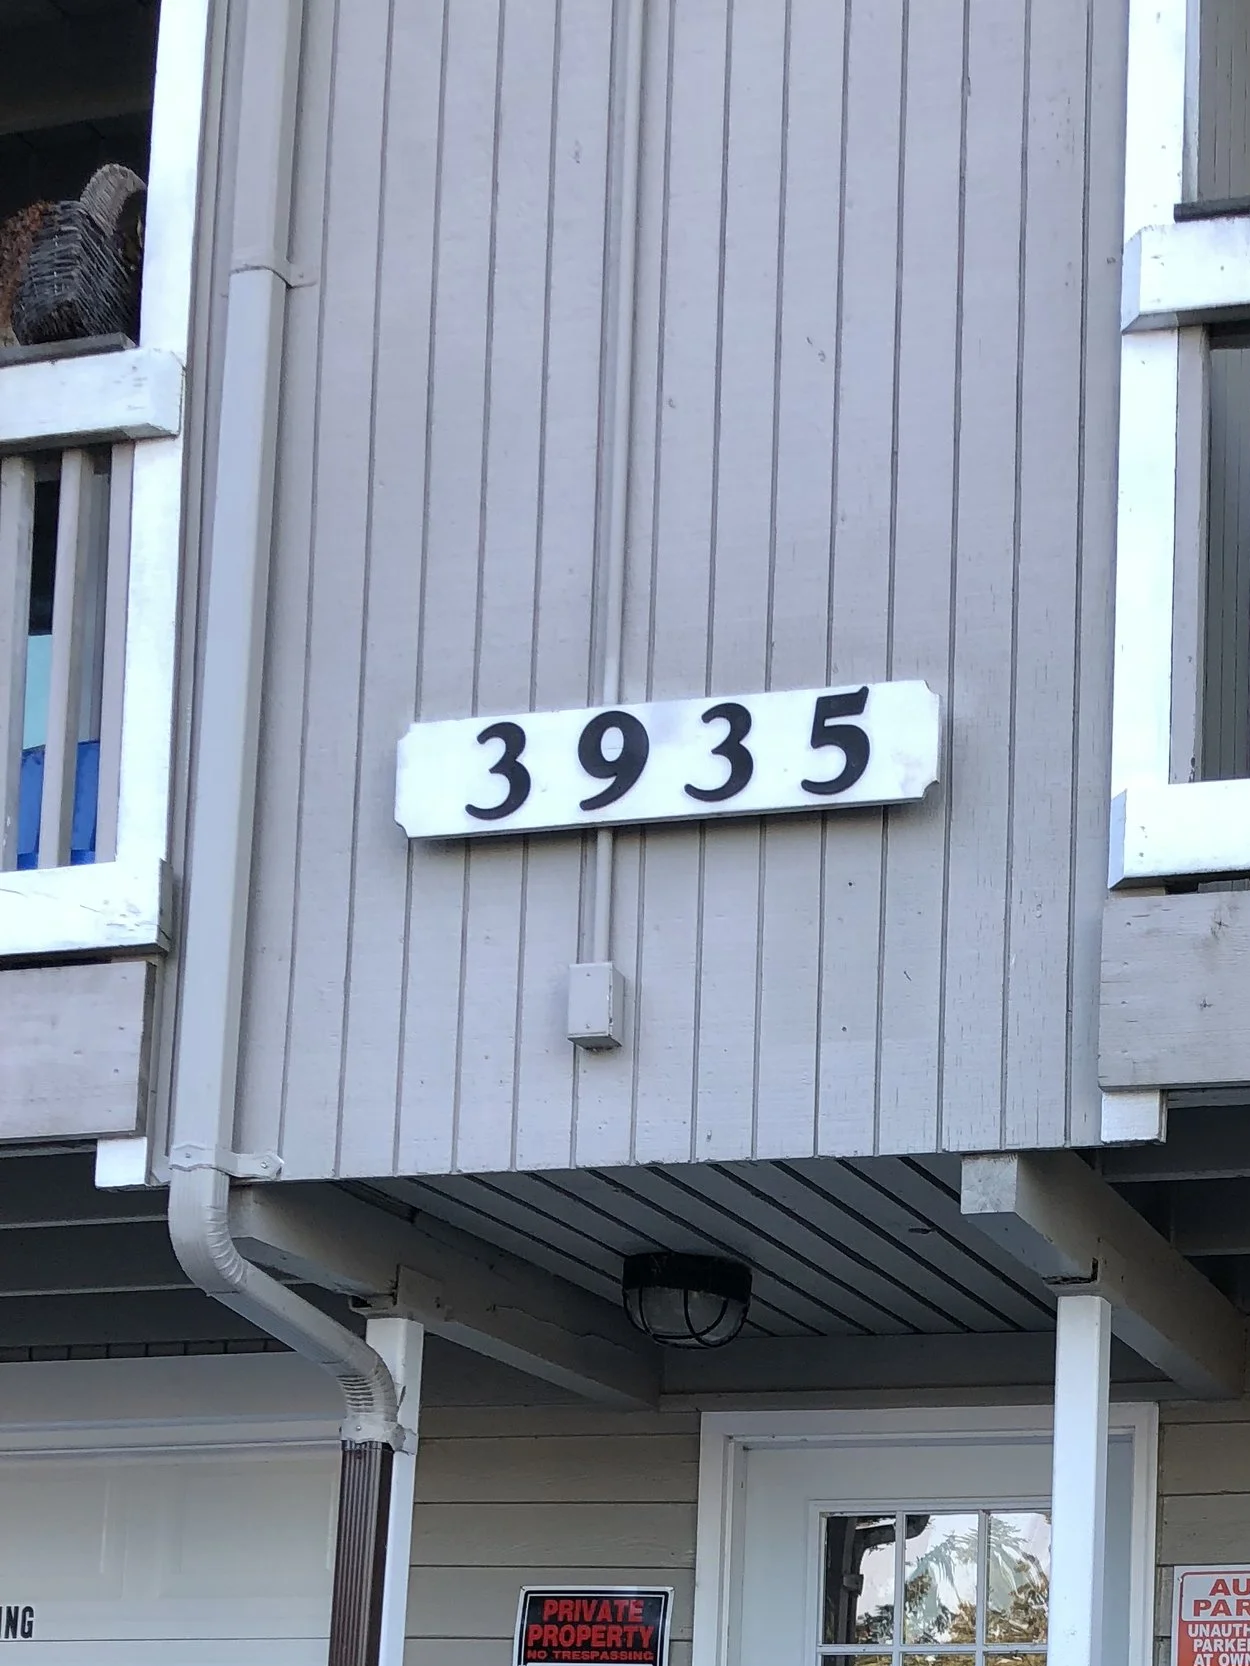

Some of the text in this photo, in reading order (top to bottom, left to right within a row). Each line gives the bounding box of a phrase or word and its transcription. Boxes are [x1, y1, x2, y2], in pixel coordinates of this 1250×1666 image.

[465, 686, 871, 820] 3935
[543, 1599, 644, 1622] PRIVATE
[527, 1624, 655, 1648] PROPERTY
[527, 1650, 654, 1660] NO TRESPASSING
[1193, 1653, 1214, 1666] AT
